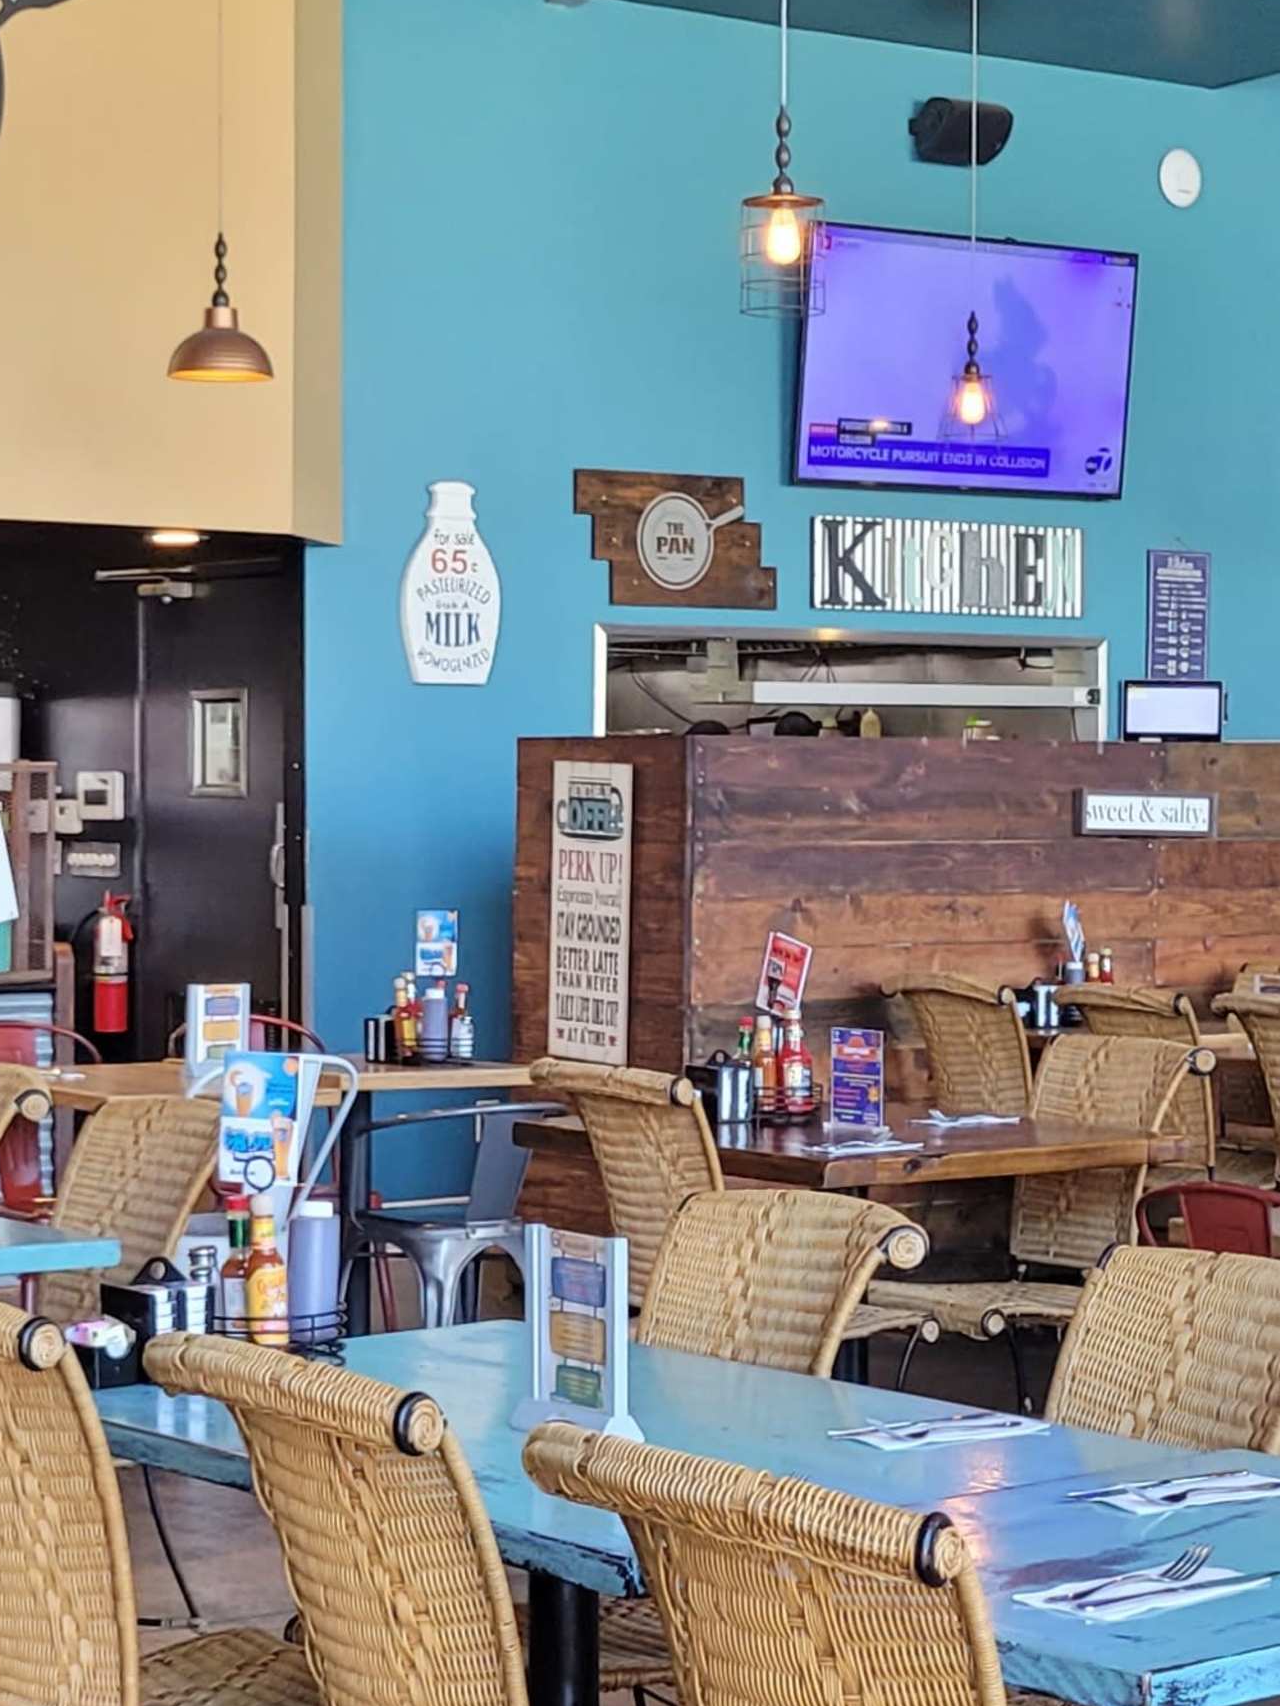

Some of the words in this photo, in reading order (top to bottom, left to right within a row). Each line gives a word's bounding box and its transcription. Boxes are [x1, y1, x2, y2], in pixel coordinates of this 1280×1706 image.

[810, 444, 889, 462] MOTORCYCLE
[891, 448, 940, 465] PURSUIT
[942, 450, 973, 466] ENDS
[975, 452, 987, 466] IN
[989, 453, 1046, 471] COLLISION
[666, 521, 685, 536] THE
[656, 536, 695, 554] PAN
[416, 577, 491, 606] PASTEURIZED
[424, 610, 481, 647] MILK
[417, 646, 490, 673] HOMOGENIZED
[1086, 802, 1133, 823] sweet
[1139, 800, 1156, 823] &
[559, 849, 595, 883] PERK
[599, 852, 623, 885] UP!
[556, 945, 590, 972] BETTER
[592, 949, 619, 976] LATTE
[556, 971, 582, 989] THAN
[586, 973, 619, 994] NEVER
